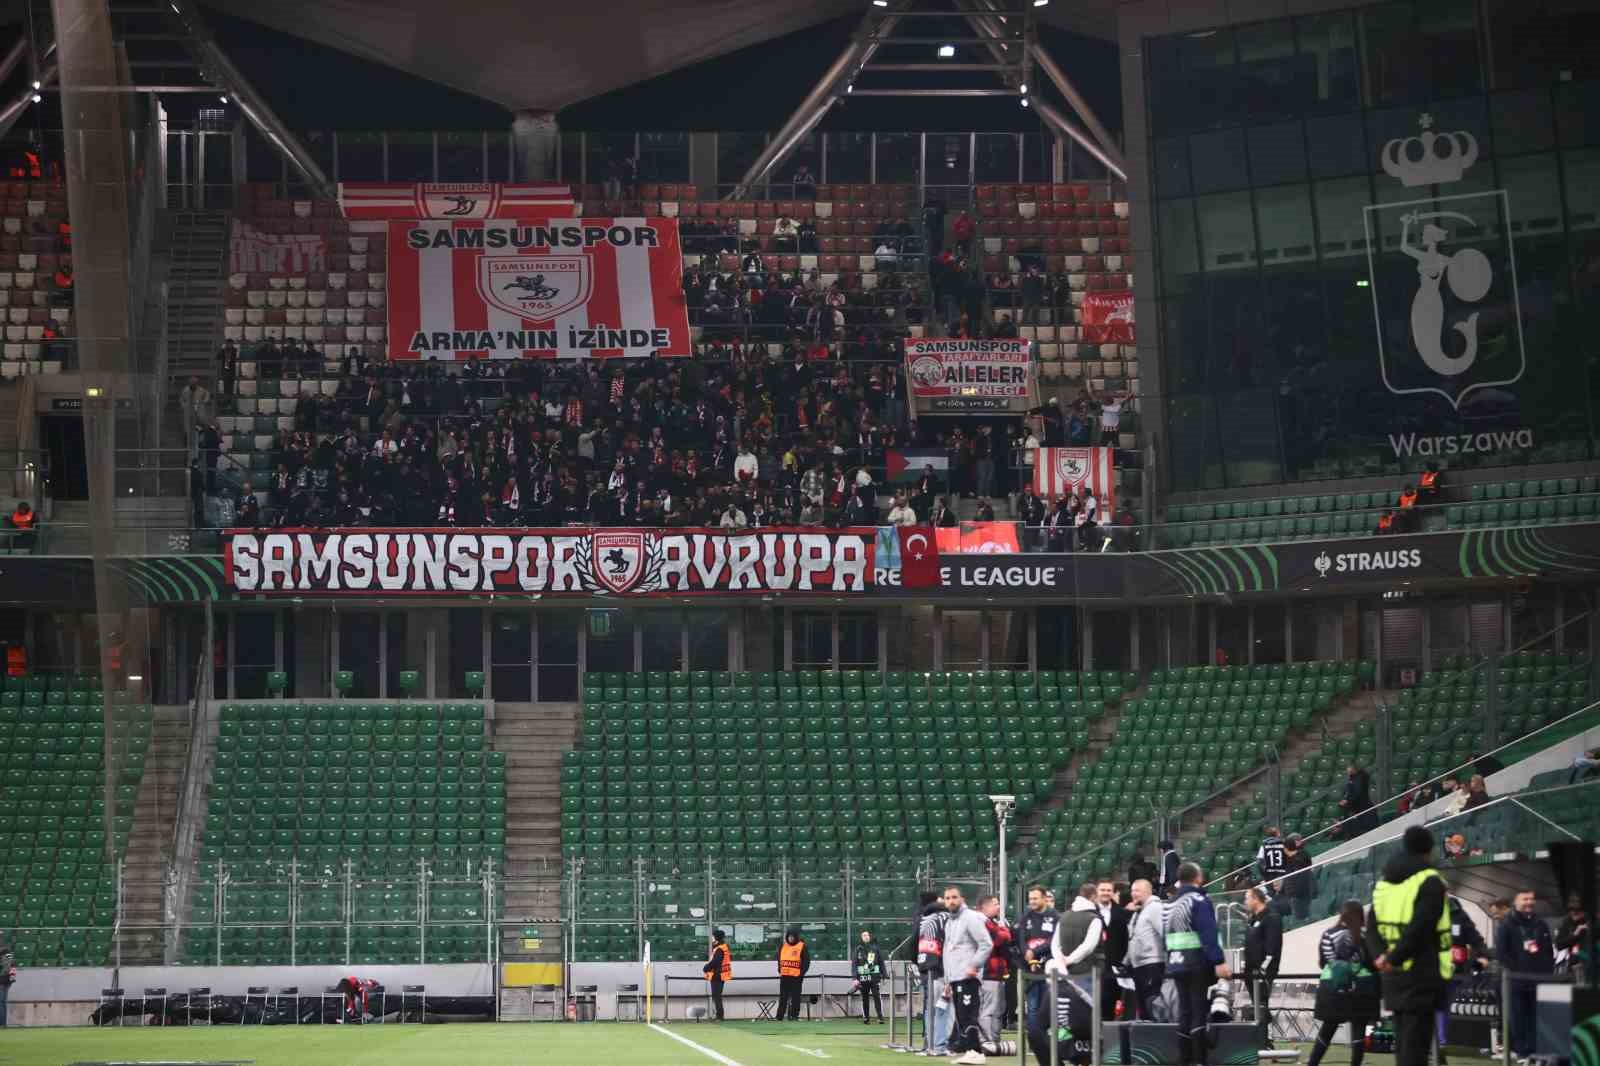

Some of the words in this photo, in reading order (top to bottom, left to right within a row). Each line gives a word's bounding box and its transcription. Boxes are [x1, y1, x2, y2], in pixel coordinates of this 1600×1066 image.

[408, 226, 659, 248] SAMSUNSPOR
[493, 263, 576, 271] SAMSUNSPOR
[521, 302, 553, 310] 1965
[568, 324, 671, 349] İZİNDE
[916, 341, 1021, 353] SAMSUNSPOR
[944, 361, 1025, 384] AİLELER
[1388, 428, 1533, 457] Warszawa
[232, 534, 583, 591] SAMSUNSPOR
[659, 534, 866, 591] AVRUPA
[1336, 549, 1422, 572] STRAUSS
[1266, 850, 1283, 868] 13
